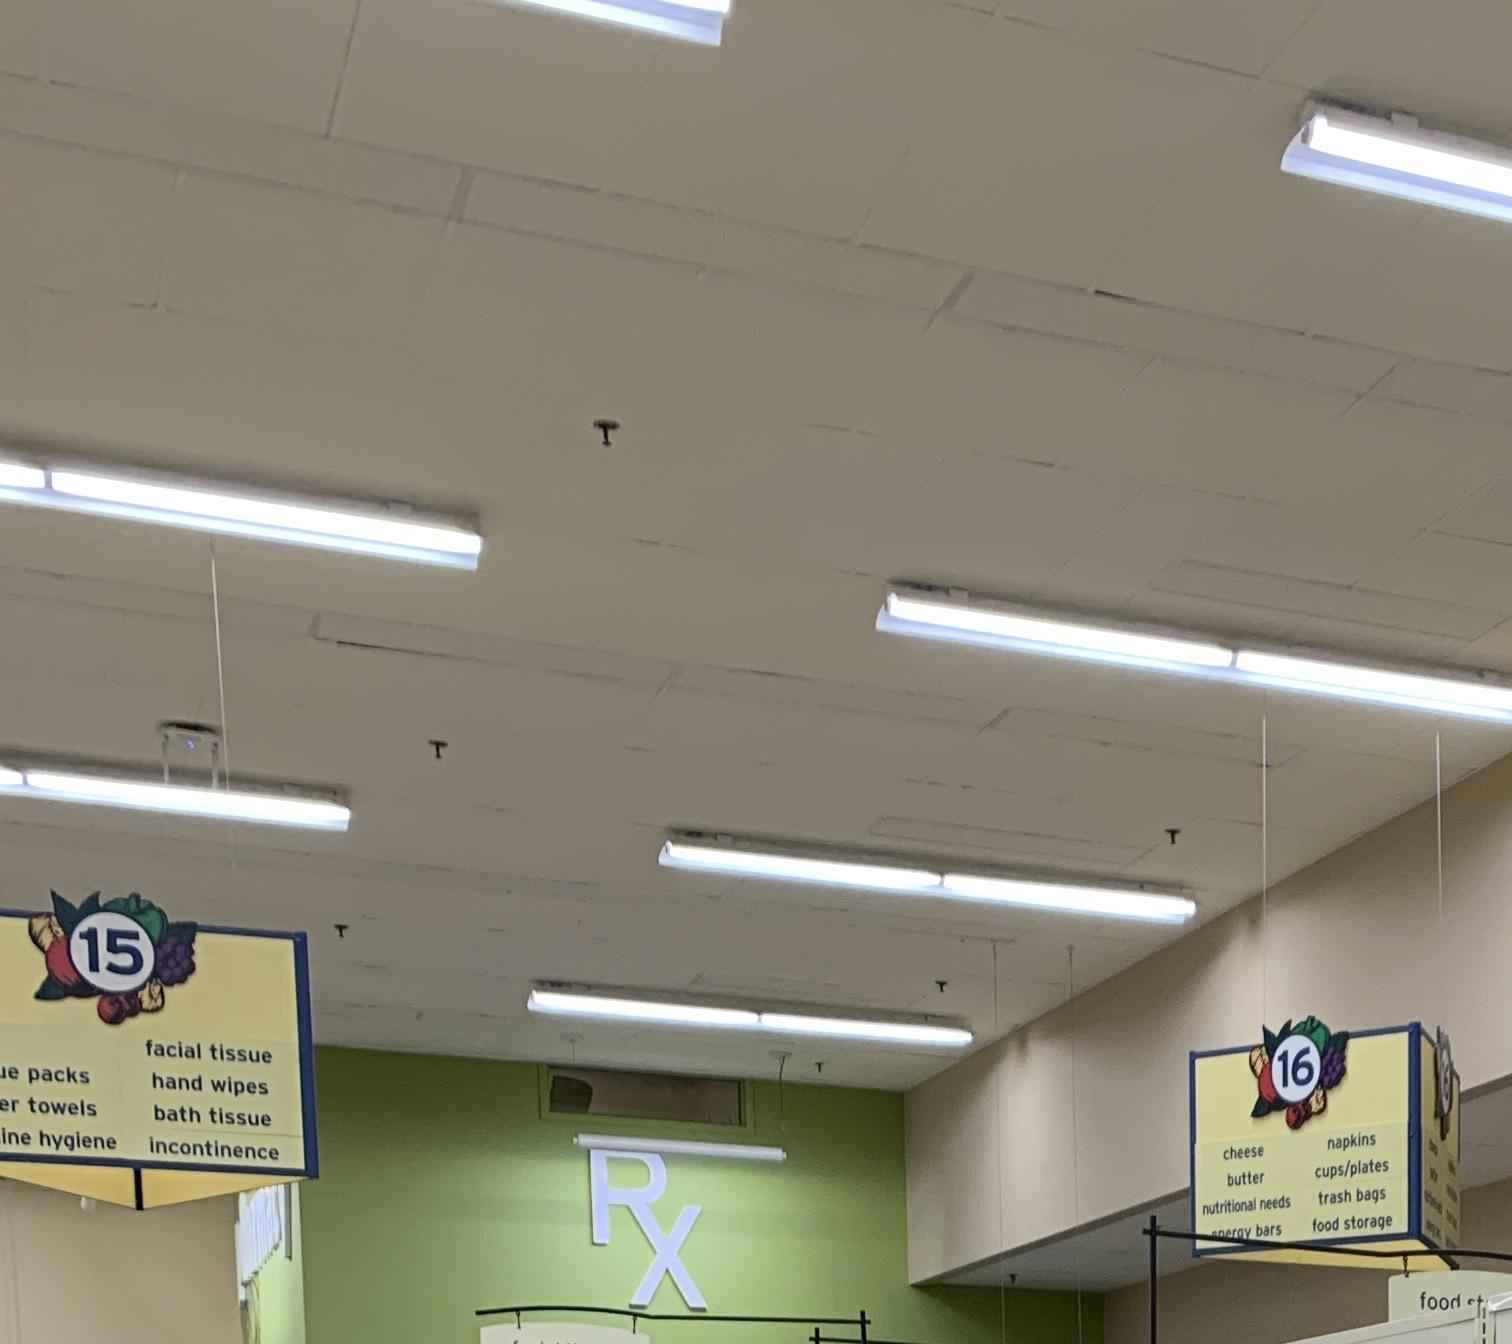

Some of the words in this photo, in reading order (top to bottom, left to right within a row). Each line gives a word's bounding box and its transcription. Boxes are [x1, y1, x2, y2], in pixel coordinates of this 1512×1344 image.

[79, 927, 144, 976] 15
[145, 1039, 202, 1060] facial
[209, 1043, 273, 1063] tissue
[28, 1066, 90, 1084] packs
[1277, 1046, 1315, 1088] 16
[152, 1073, 202, 1092] hand
[211, 1076, 269, 1097] wipes
[27, 1096, 97, 1117] towels
[154, 1104, 201, 1124] bath
[209, 1107, 272, 1127] tissue
[39, 1129, 117, 1151] hygiene
[149, 1137, 280, 1161] incontinence
[1327, 1132, 1376, 1152] napkins
[1223, 1143, 1264, 1161] cheese
[1227, 1171, 1265, 1187] butter
[1314, 1158, 1390, 1179] cups/plates
[1202, 1197, 1257, 1216] nutritional
[1259, 1194, 1291, 1210] needs
[1318, 1189, 1352, 1205] trash
[1356, 1186, 1386, 1205] bags
[1256, 1223, 1282, 1237] bars
[1312, 1216, 1340, 1233] food
[1344, 1213, 1393, 1233] storage
[1420, 1291, 1461, 1310] food
